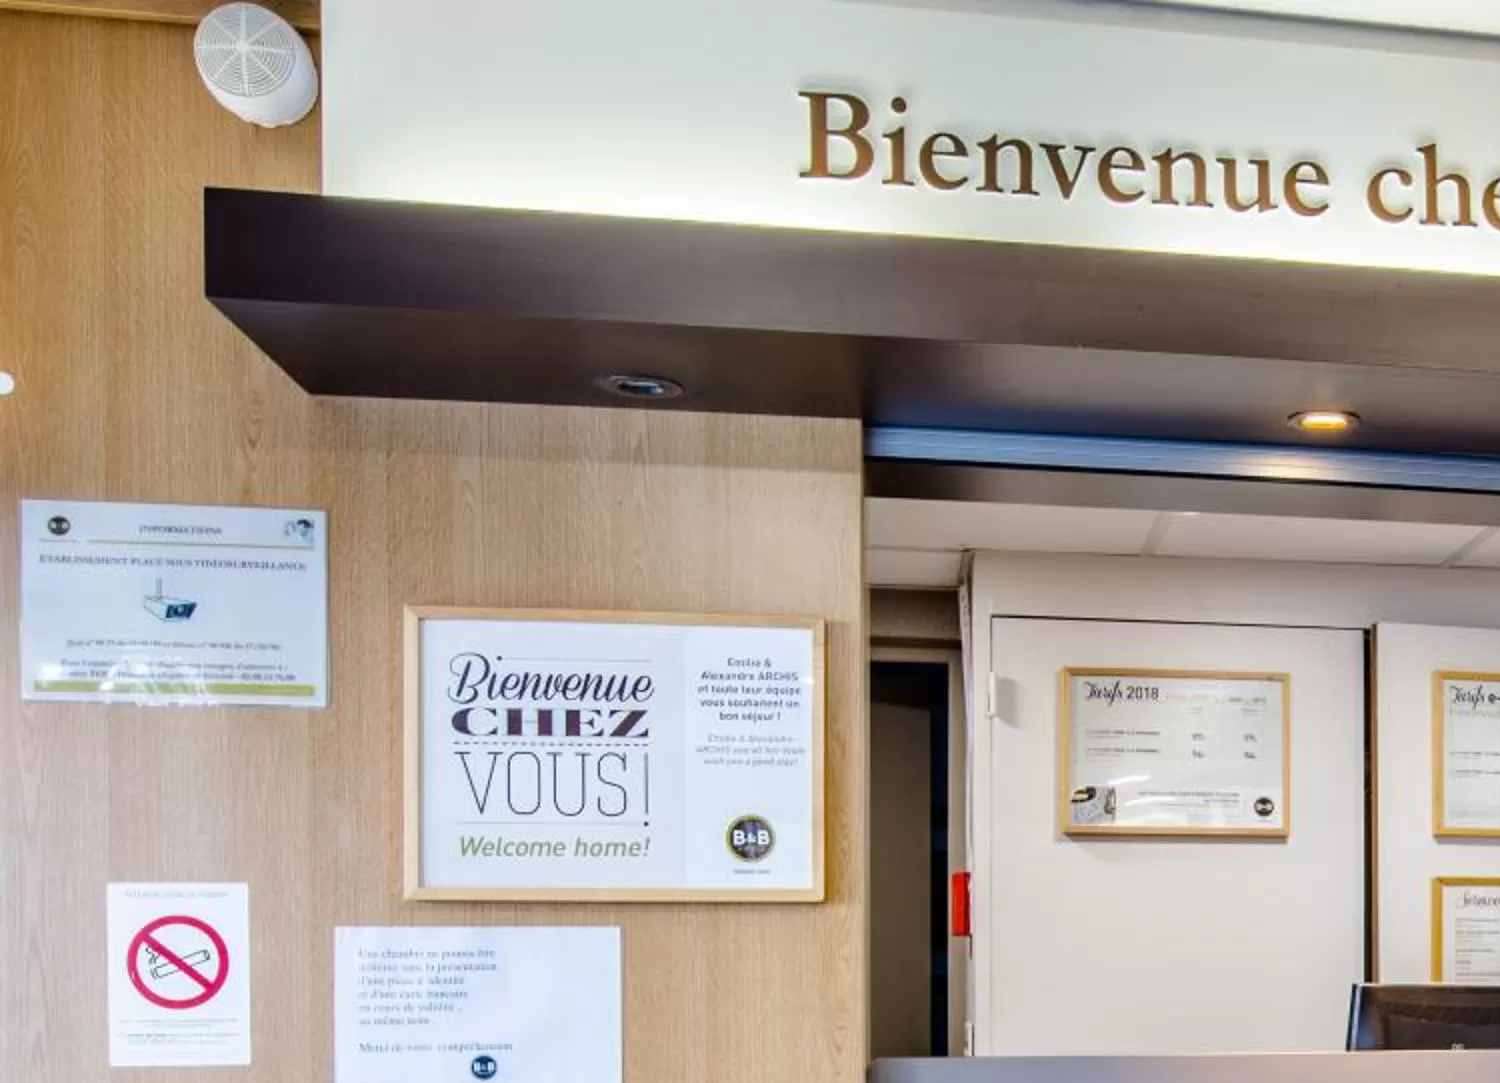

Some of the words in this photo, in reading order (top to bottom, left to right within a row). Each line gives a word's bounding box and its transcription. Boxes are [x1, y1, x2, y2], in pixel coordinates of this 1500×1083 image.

[799, 91, 1331, 216] Bienvenue
[448, 652, 654, 705] Bienvenue
[1126, 686, 1159, 701] 2018
[451, 707, 650, 738] CHEZ
[459, 836, 566, 858] Welcome
[574, 837, 651, 859] home!
